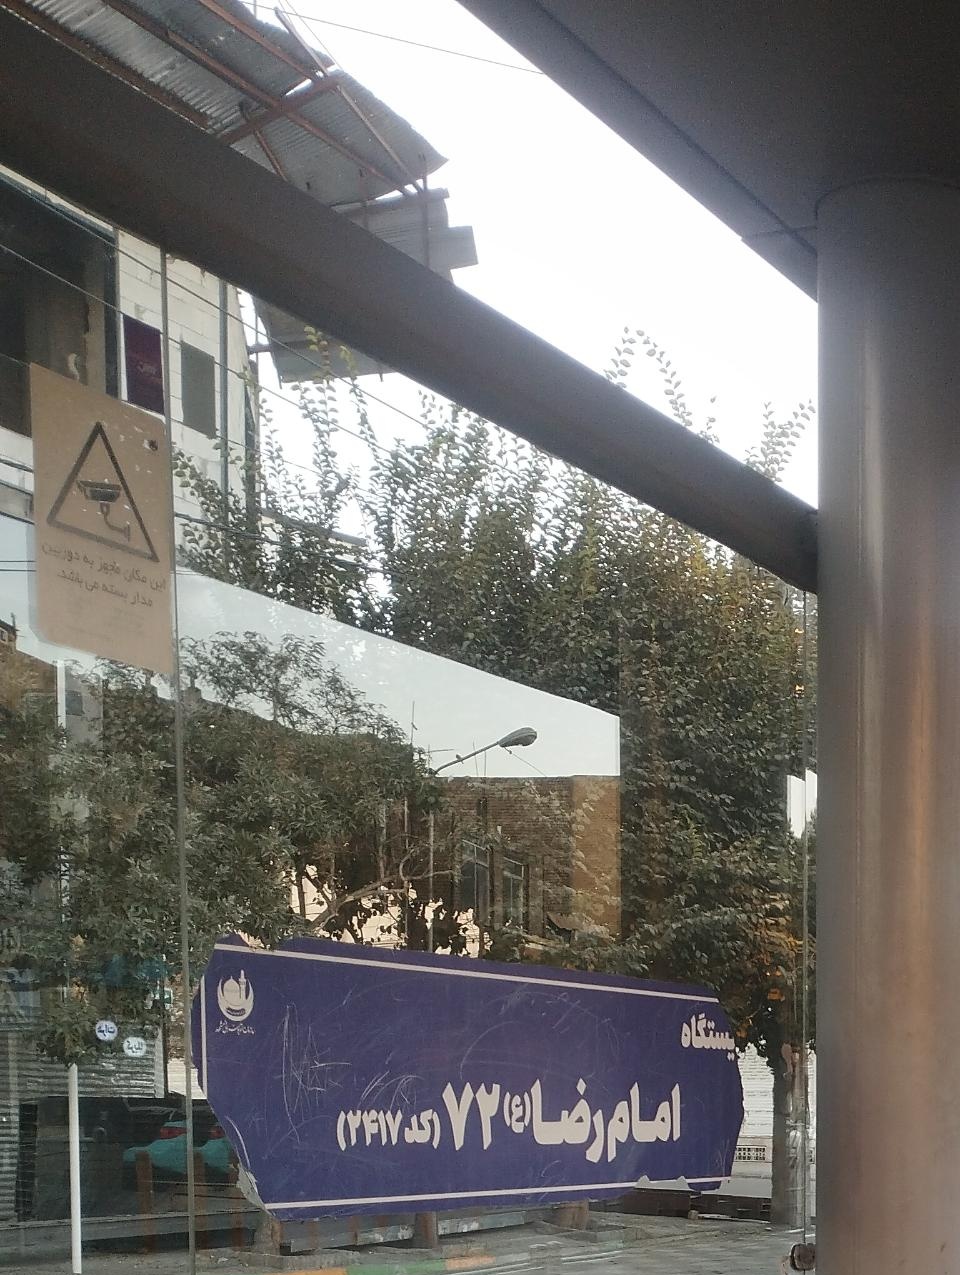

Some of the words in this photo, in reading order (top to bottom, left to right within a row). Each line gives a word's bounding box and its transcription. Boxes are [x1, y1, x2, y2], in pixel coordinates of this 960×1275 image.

[150, 578, 167, 592] این
[681, 1012, 736, 1061] یستگاه
[607, 1081, 681, 1163] امام
